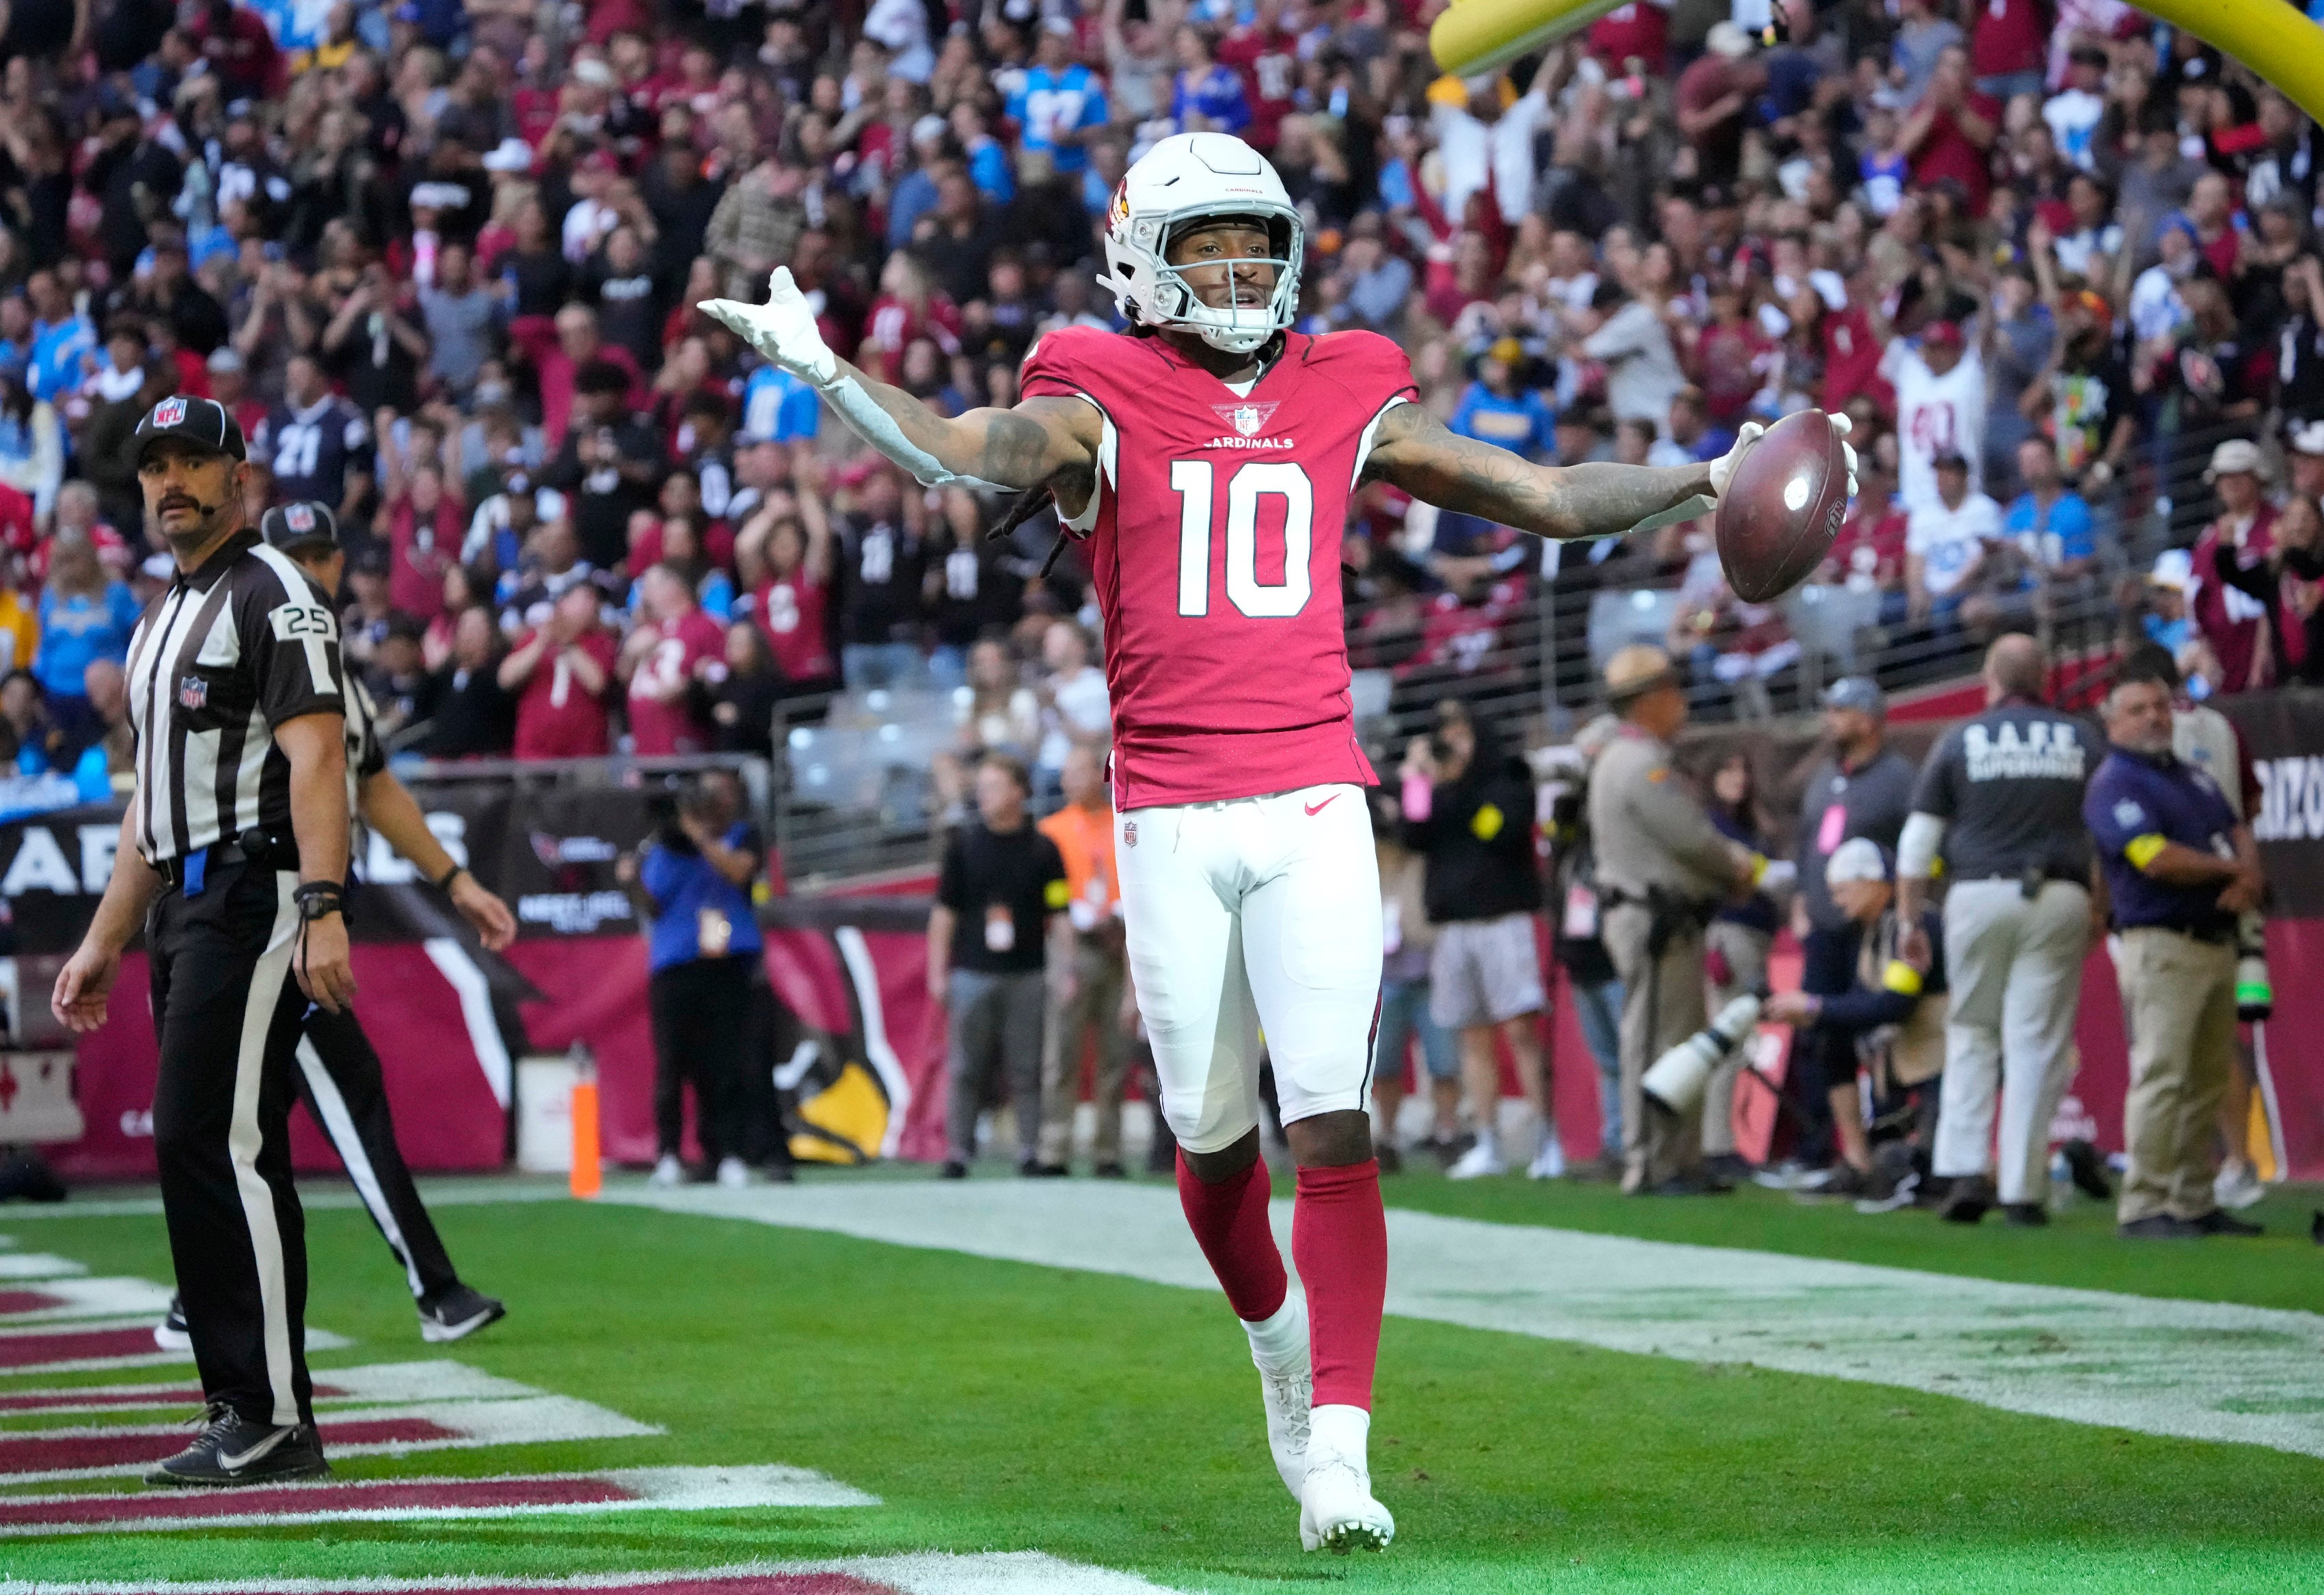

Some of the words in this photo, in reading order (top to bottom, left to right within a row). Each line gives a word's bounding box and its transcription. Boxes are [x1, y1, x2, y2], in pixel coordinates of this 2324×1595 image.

[157, 408, 182, 422] NFL
[1170, 459, 1314, 618] 10
[283, 607, 328, 634] 25
[183, 688, 206, 707] NFL
[1124, 831, 1136, 843] NFL
